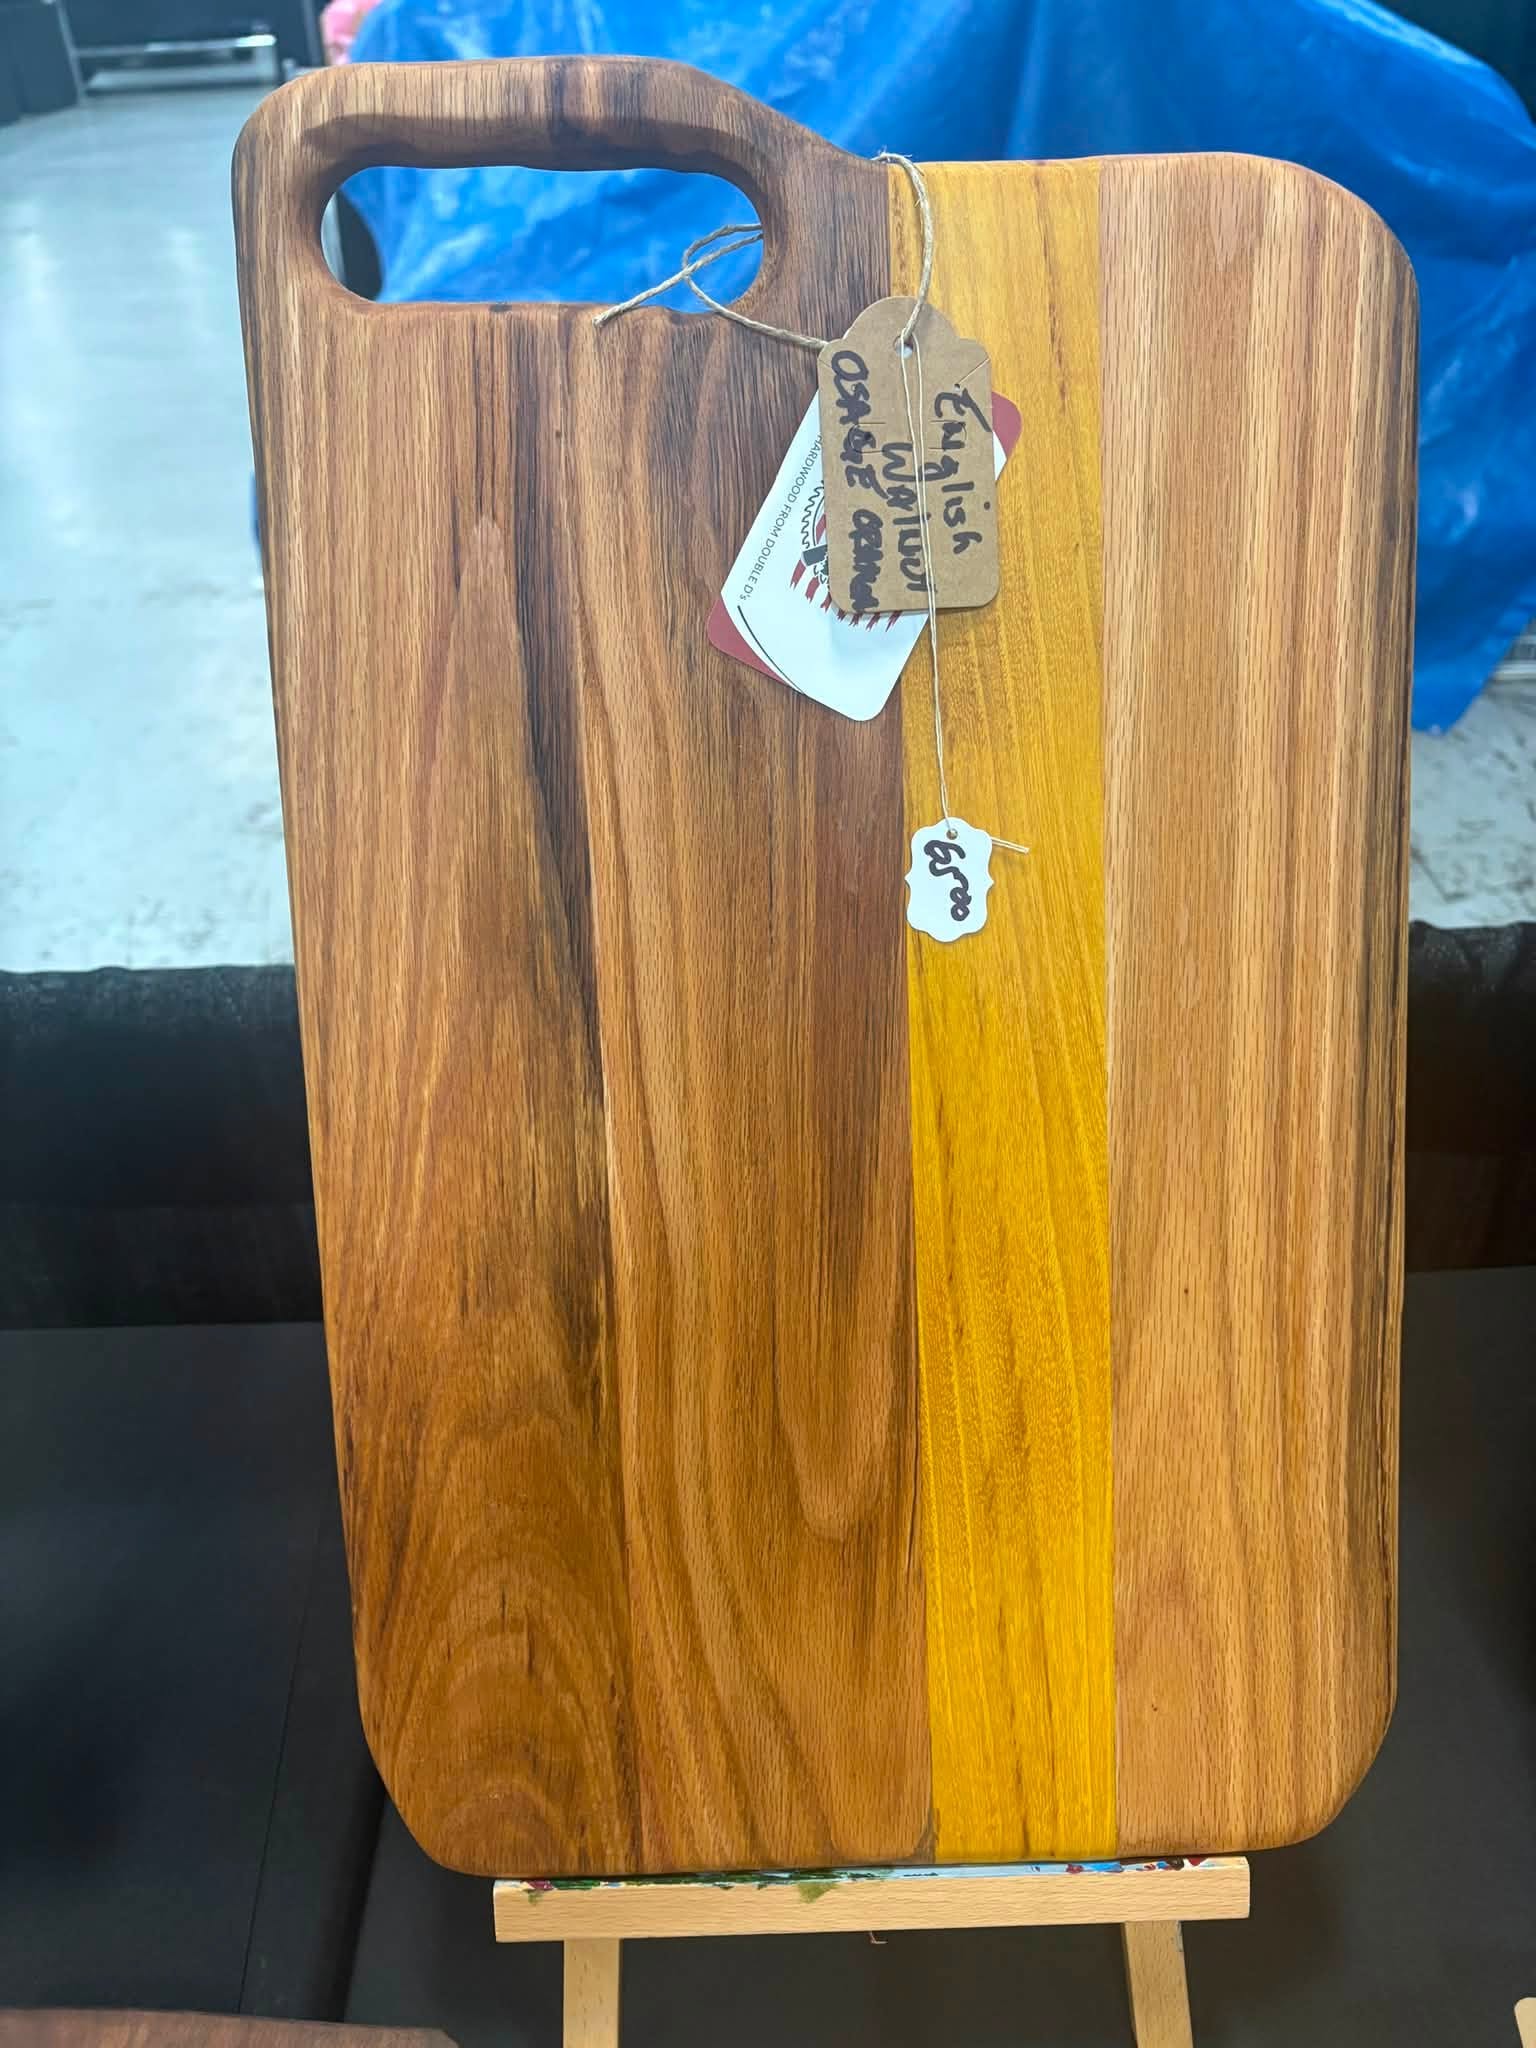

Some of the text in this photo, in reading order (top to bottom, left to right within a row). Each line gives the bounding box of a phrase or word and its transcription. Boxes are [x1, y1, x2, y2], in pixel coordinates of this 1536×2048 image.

[787, 434, 822, 503] HARDWOOD
[770, 505, 792, 537] FROM
[751, 537, 776, 584] DOUBLE
